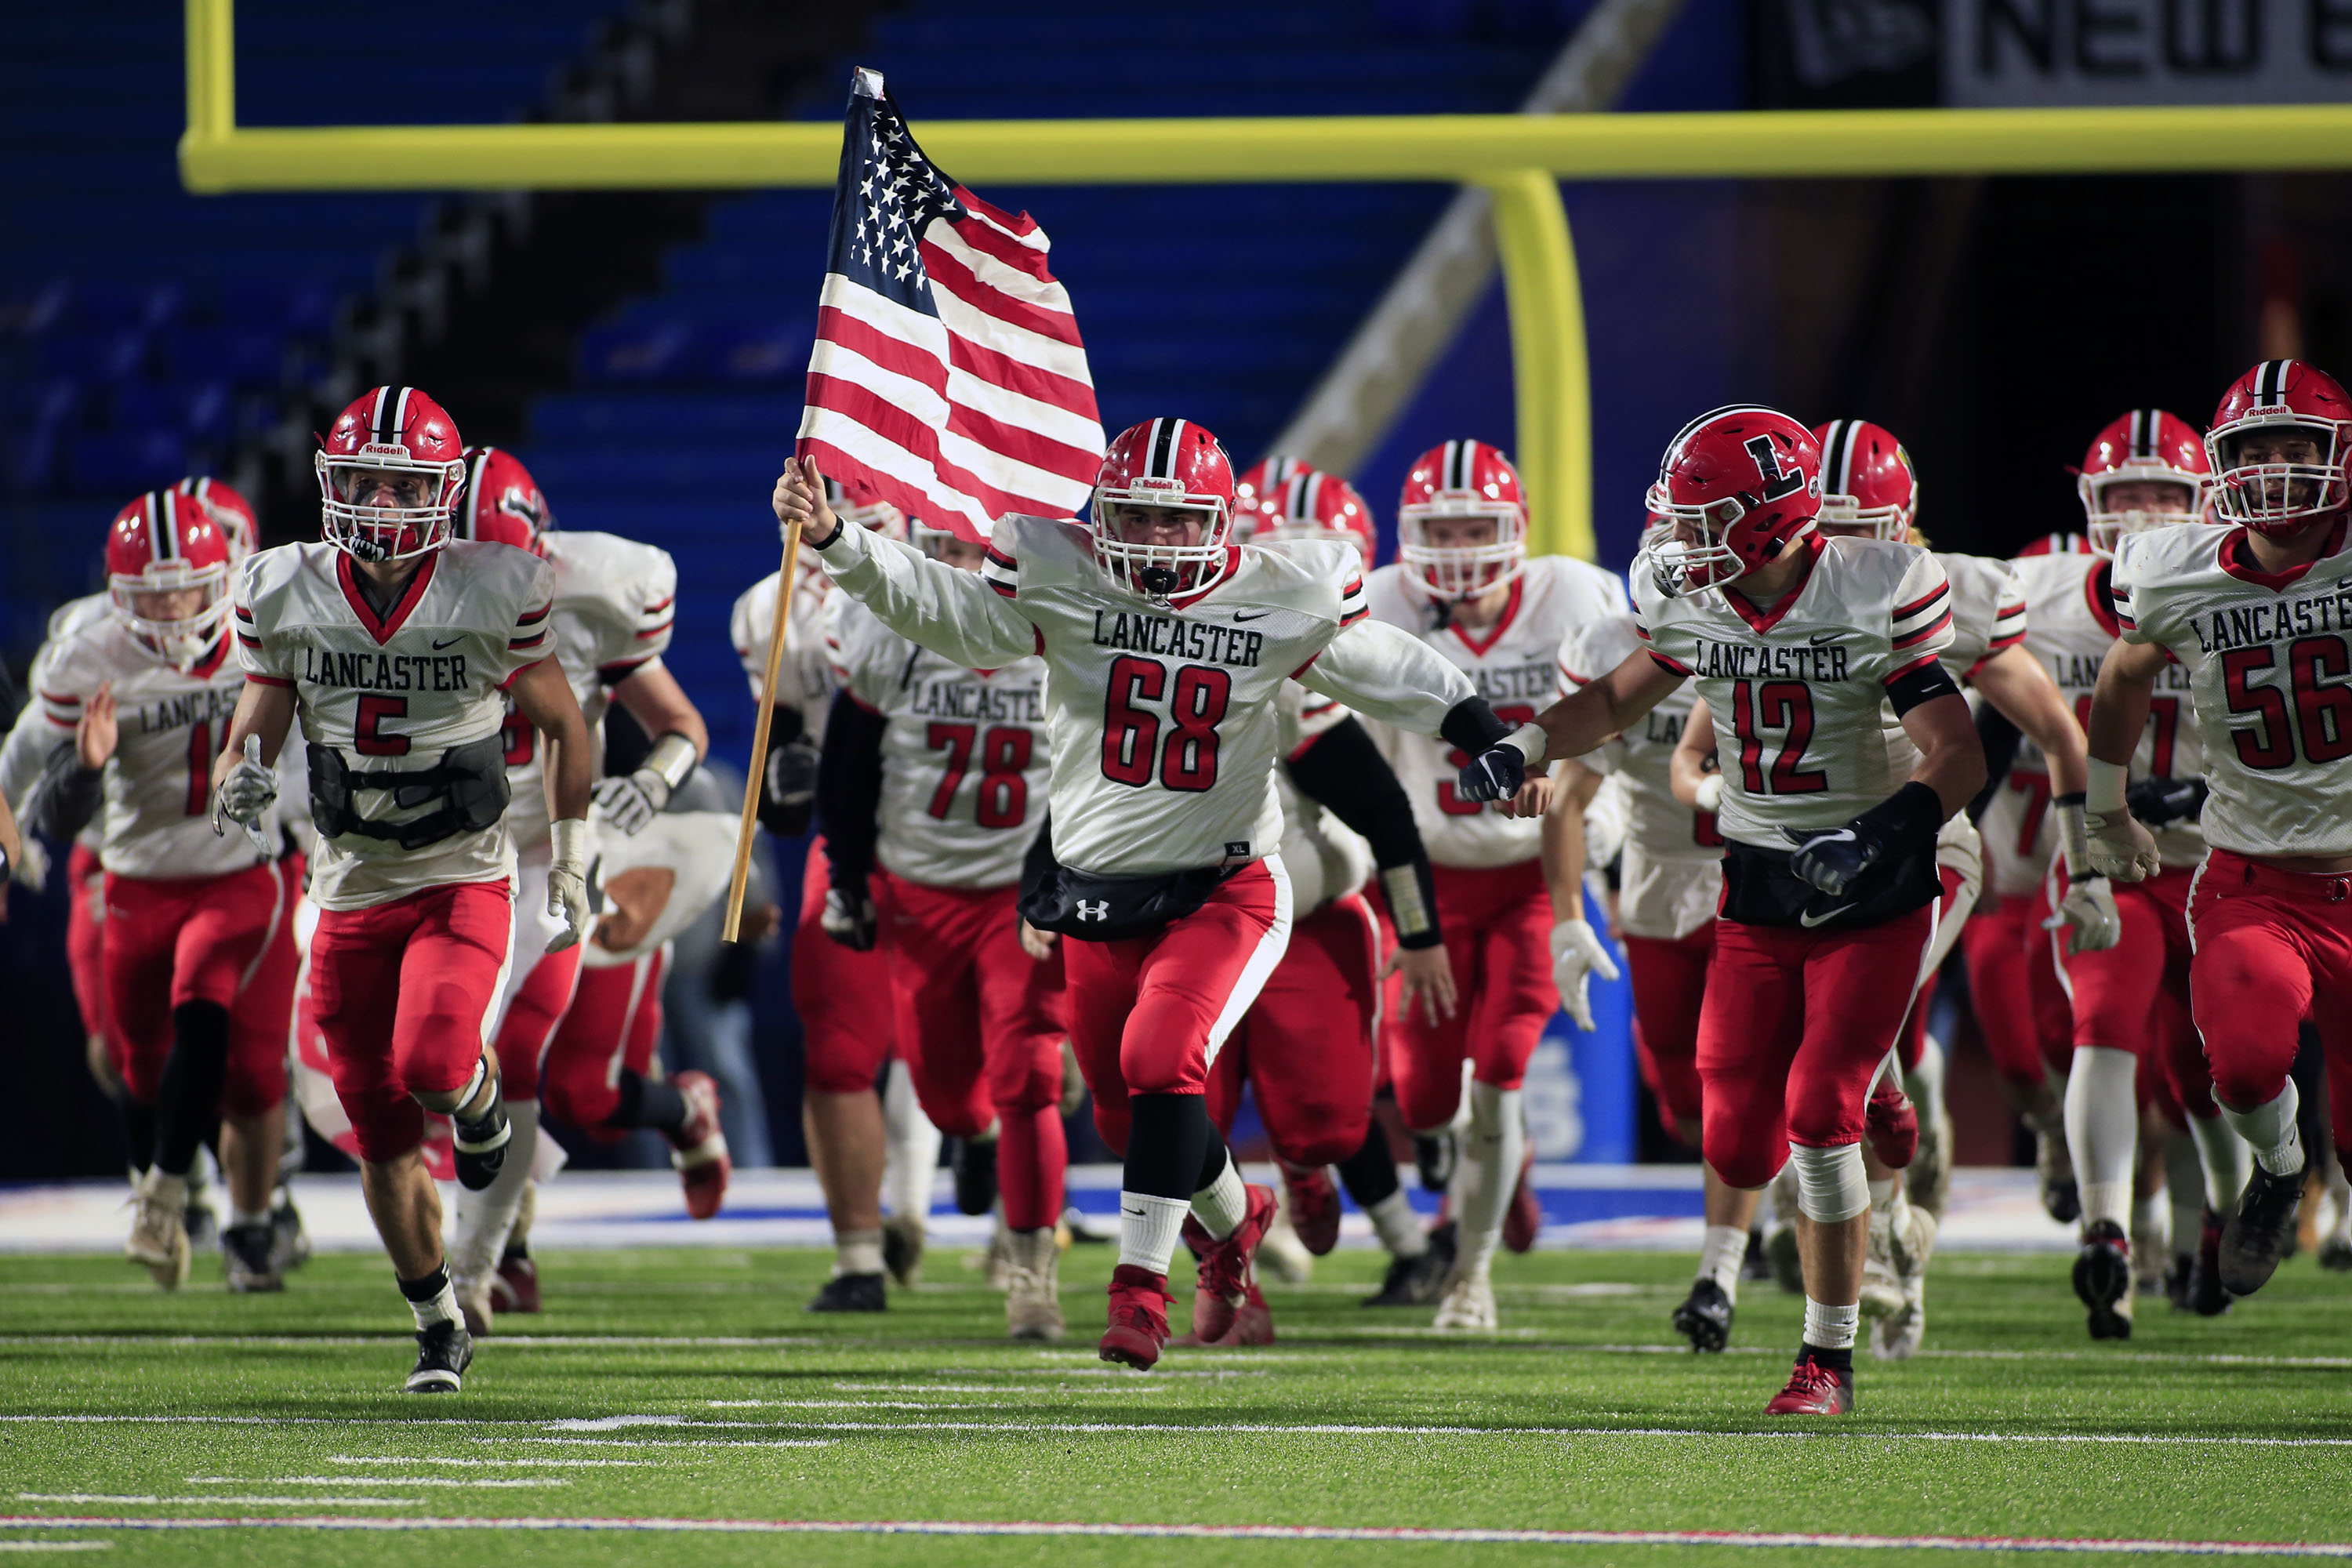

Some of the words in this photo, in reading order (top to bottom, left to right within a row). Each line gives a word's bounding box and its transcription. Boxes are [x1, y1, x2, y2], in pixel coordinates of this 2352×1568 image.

[2249, 405, 2287, 417] Riddell
[366, 445, 403, 456] Riddell
[1744, 434, 1806, 503] L
[1143, 479, 1173, 490] Riddell
[1093, 609, 1264, 667] LANCASTER
[2190, 592, 2352, 653] LANCASTE
[306, 646, 469, 691] LANCASTER
[1696, 639, 1849, 682] LANCASTER
[140, 679, 246, 734] LANCAS
[912, 680, 1045, 722] LANCASTE
[1101, 654, 1232, 793] 68
[2221, 633, 2352, 770] 56
[1732, 678, 1829, 795] 12
[926, 720, 1033, 829] 78
[1232, 844, 1246, 854] XL
